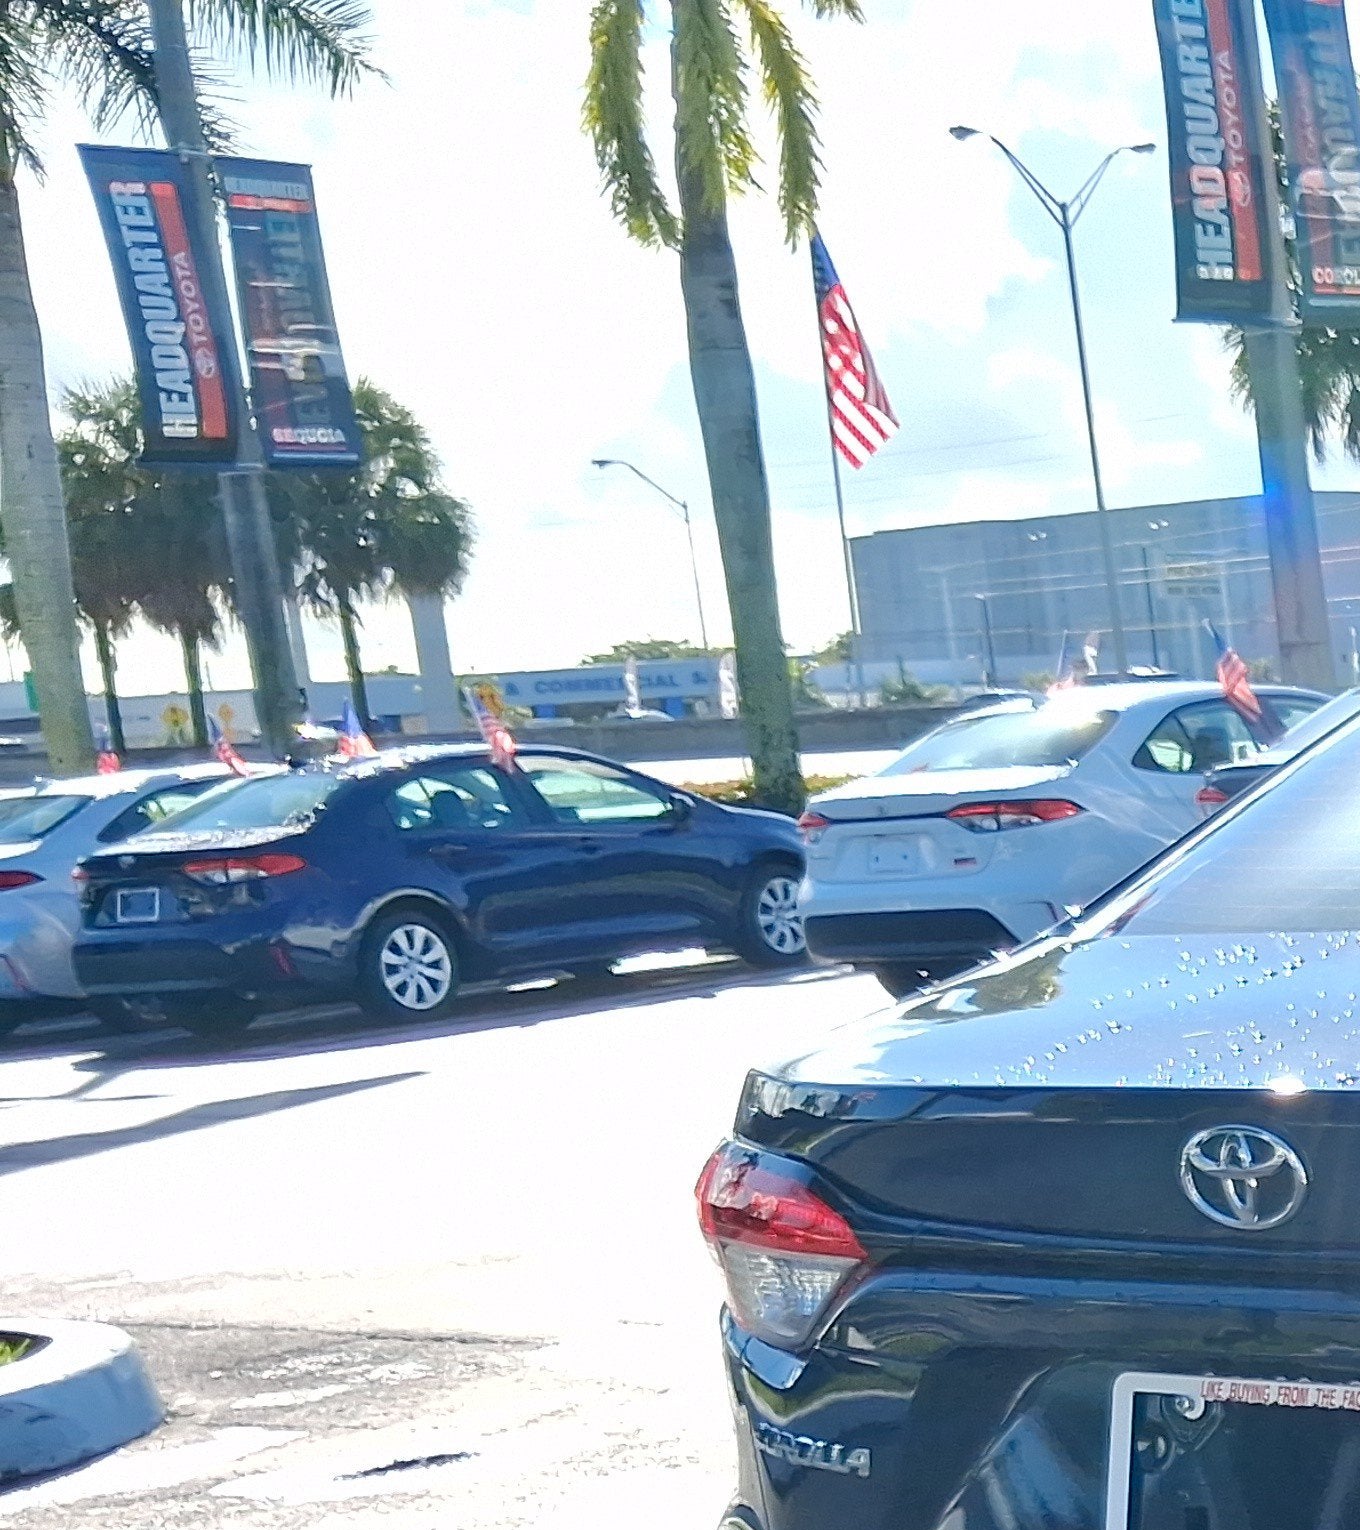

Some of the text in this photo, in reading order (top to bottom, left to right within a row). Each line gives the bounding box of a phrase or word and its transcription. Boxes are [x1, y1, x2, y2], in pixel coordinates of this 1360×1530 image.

[1215, 50, 1247, 167] TOYOTA
[109, 181, 199, 439] HEADQUARTER
[170, 251, 209, 346] TOYOTA
[535, 674, 679, 694] COMMERIAL
[1201, 1379, 1224, 1399] LIKE
[1228, 1382, 1271, 1402] BUYING
[1277, 1385, 1310, 1405] FROM
[1315, 1387, 1337, 1407] THE
